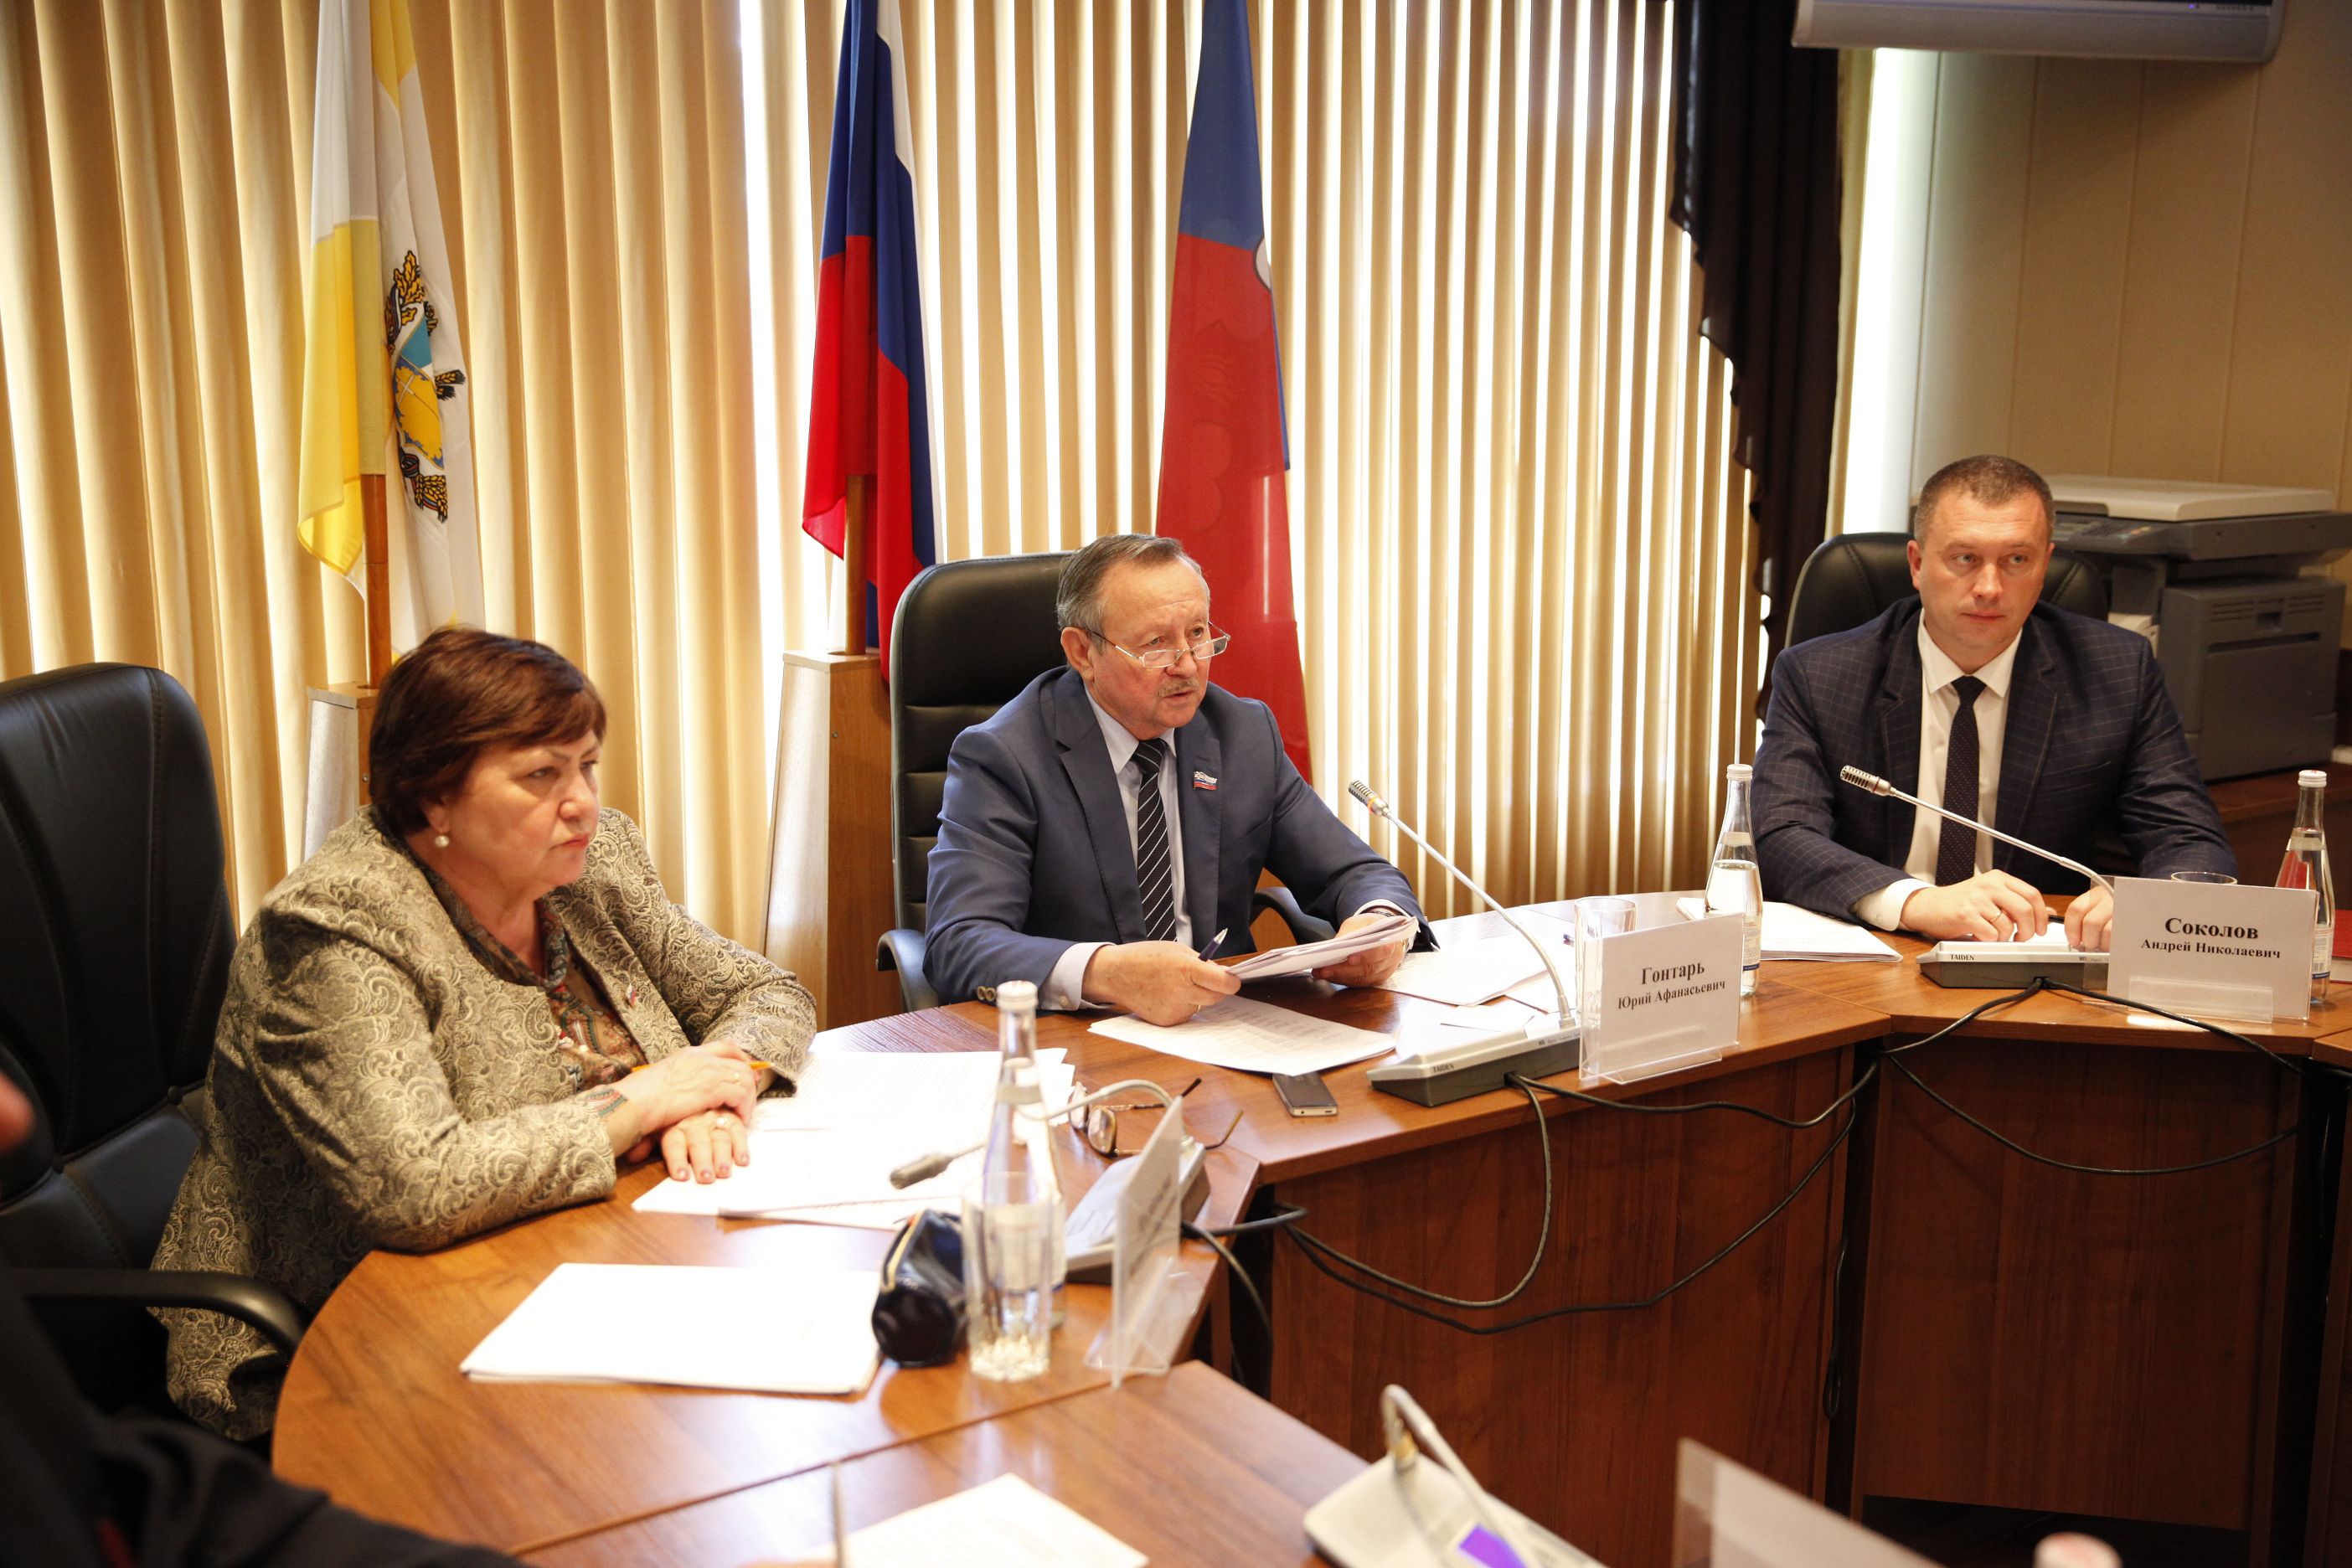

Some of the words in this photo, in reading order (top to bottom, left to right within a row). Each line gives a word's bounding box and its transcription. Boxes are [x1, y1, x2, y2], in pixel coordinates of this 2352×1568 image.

[2165, 917, 2259, 939] Соколов
[2141, 938, 2191, 953] Андрей
[2195, 942, 2281, 959] Николаевич
[1641, 962, 1705, 985] Гонтарь
[1617, 992, 1652, 1010] Юрий
[1654, 980, 1725, 1003] Афанасьевич
